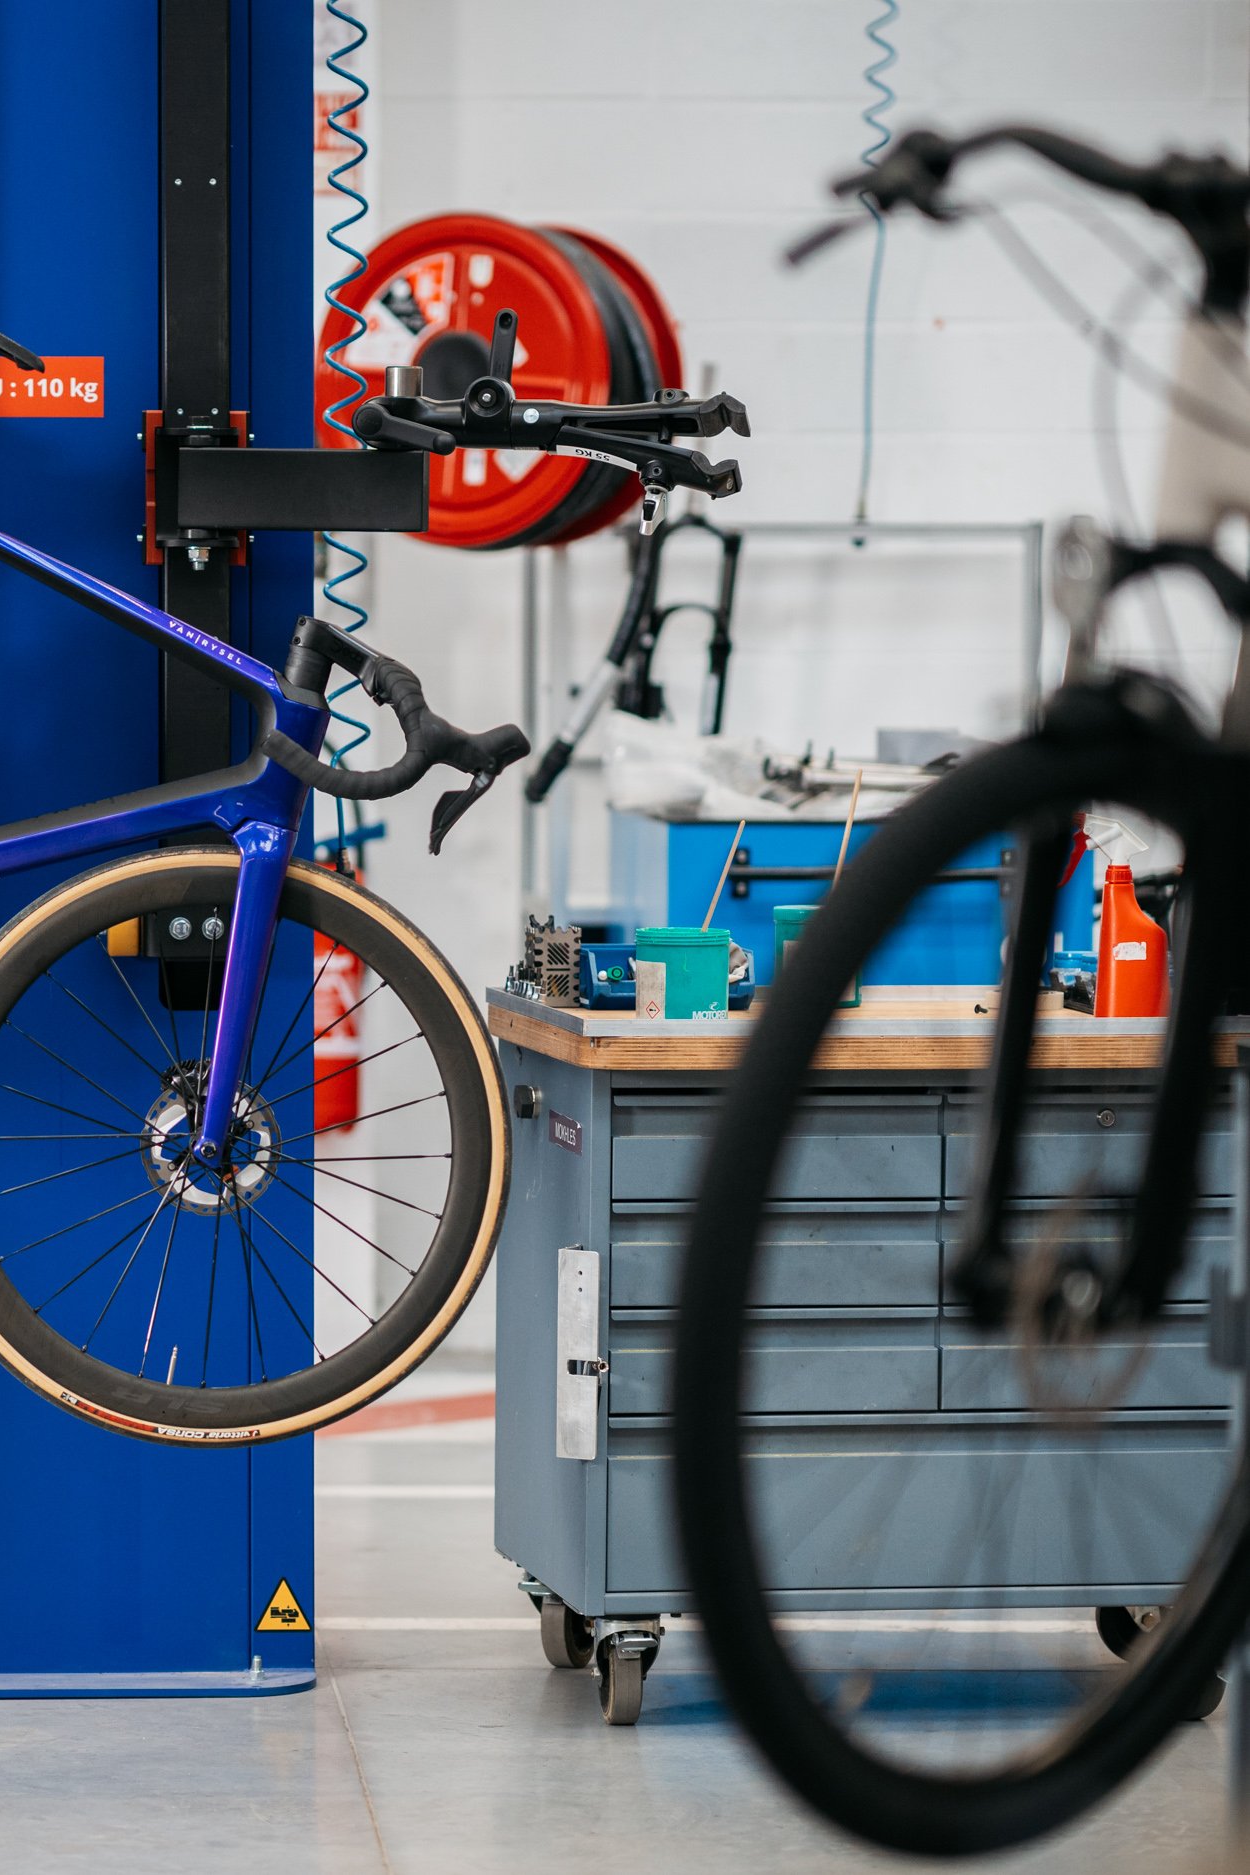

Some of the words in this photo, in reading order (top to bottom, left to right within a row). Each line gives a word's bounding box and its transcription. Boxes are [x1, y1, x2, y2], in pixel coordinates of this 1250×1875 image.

[10, 382, 16, 397] :
[23, 377, 64, 397] 110
[70, 376, 99, 403] kg
[575, 448, 592, 457] KG
[595, 453, 610, 461] 55
[555, 1121, 576, 1146] MOKHLES
[157, 1427, 204, 1439] CORSA
[207, 1430, 250, 1439] vittoria
